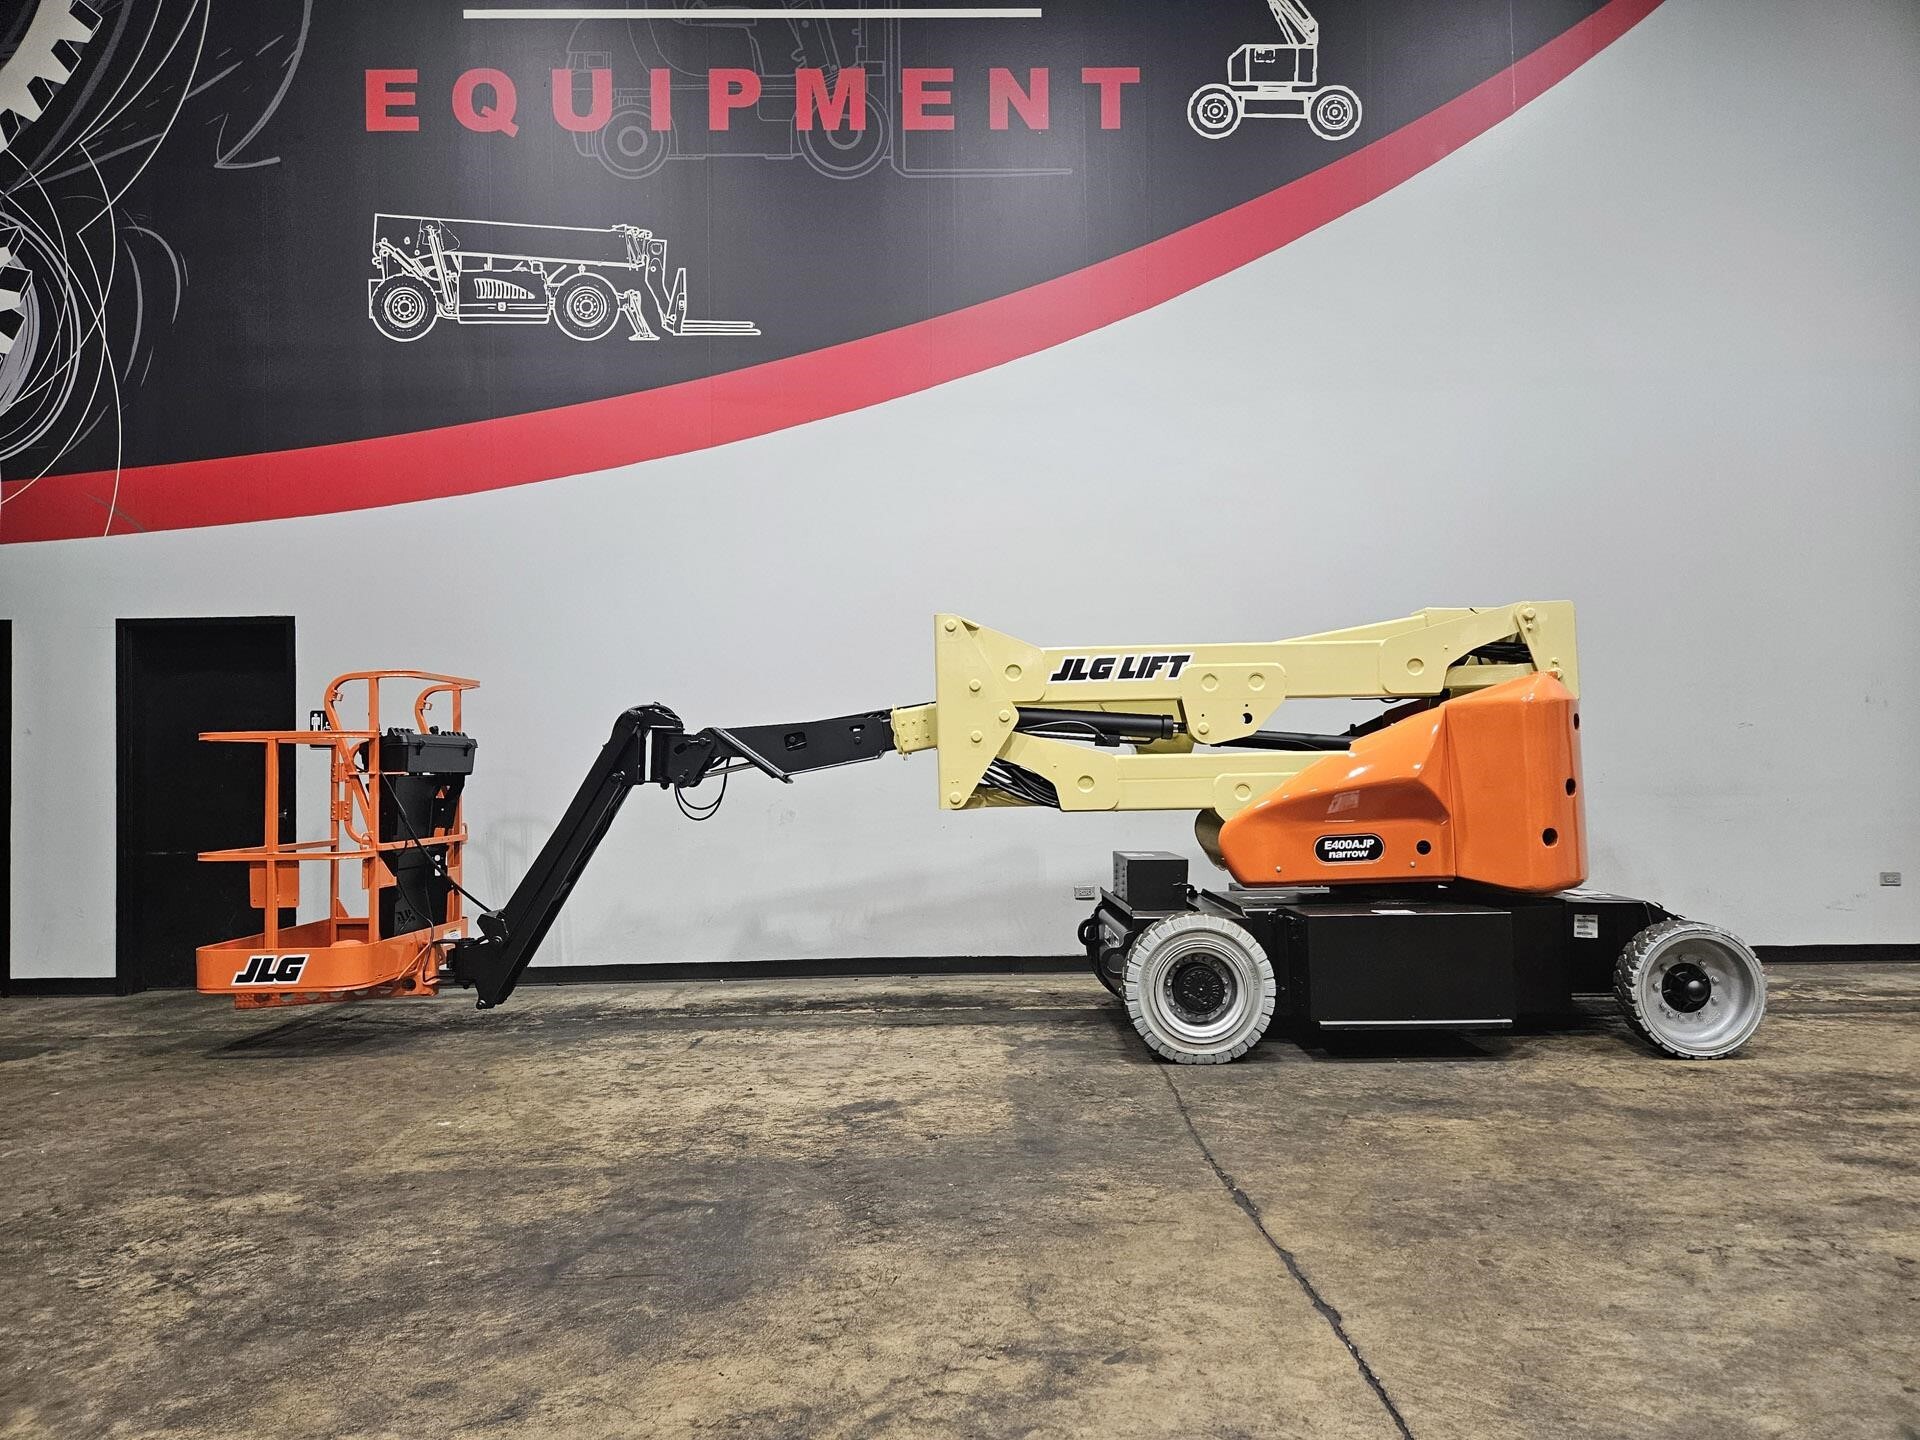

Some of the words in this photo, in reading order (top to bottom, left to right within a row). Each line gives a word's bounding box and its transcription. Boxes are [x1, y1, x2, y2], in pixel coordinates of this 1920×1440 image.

[365, 67, 1141, 135] EQUIPMENT
[1050, 657, 1117, 682] JLG
[1117, 655, 1191, 679] LIFT
[1323, 838, 1376, 851] E400AJP
[1328, 849, 1370, 859] narrow
[234, 956, 307, 984] JLG
